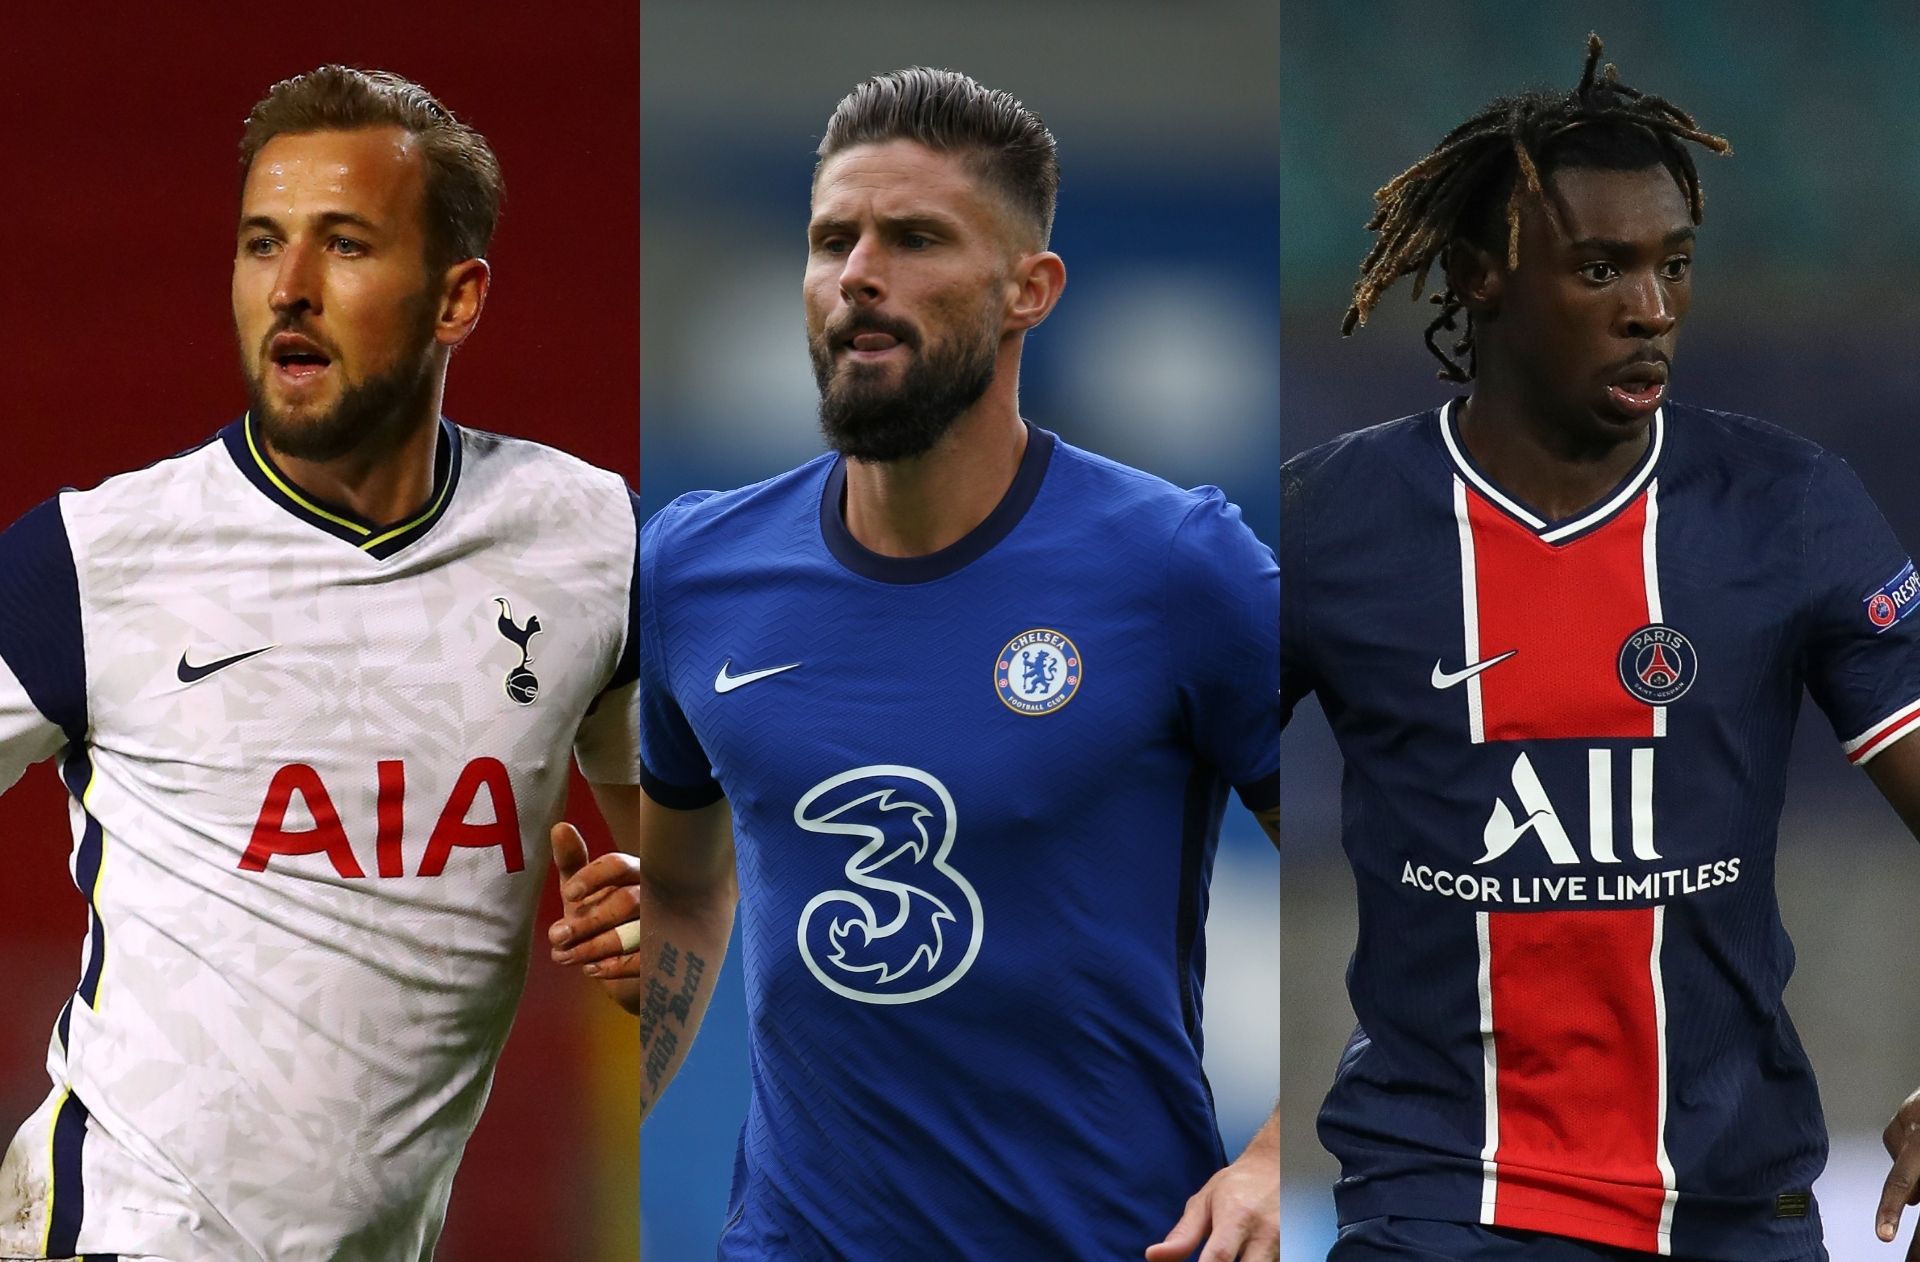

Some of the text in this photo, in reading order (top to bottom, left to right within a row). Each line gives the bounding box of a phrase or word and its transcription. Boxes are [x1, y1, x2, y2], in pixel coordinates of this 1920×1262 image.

[1010, 632, 1066, 652] CHELSEA
[1632, 630, 1684, 650] PARIS
[1008, 694, 1066, 711] FOOTBALL CLUB
[236, 756, 526, 879] AIA
[793, 764, 985, 1005] 3
[1401, 857, 1742, 904] ACCOR LIVE LIMITLESS
